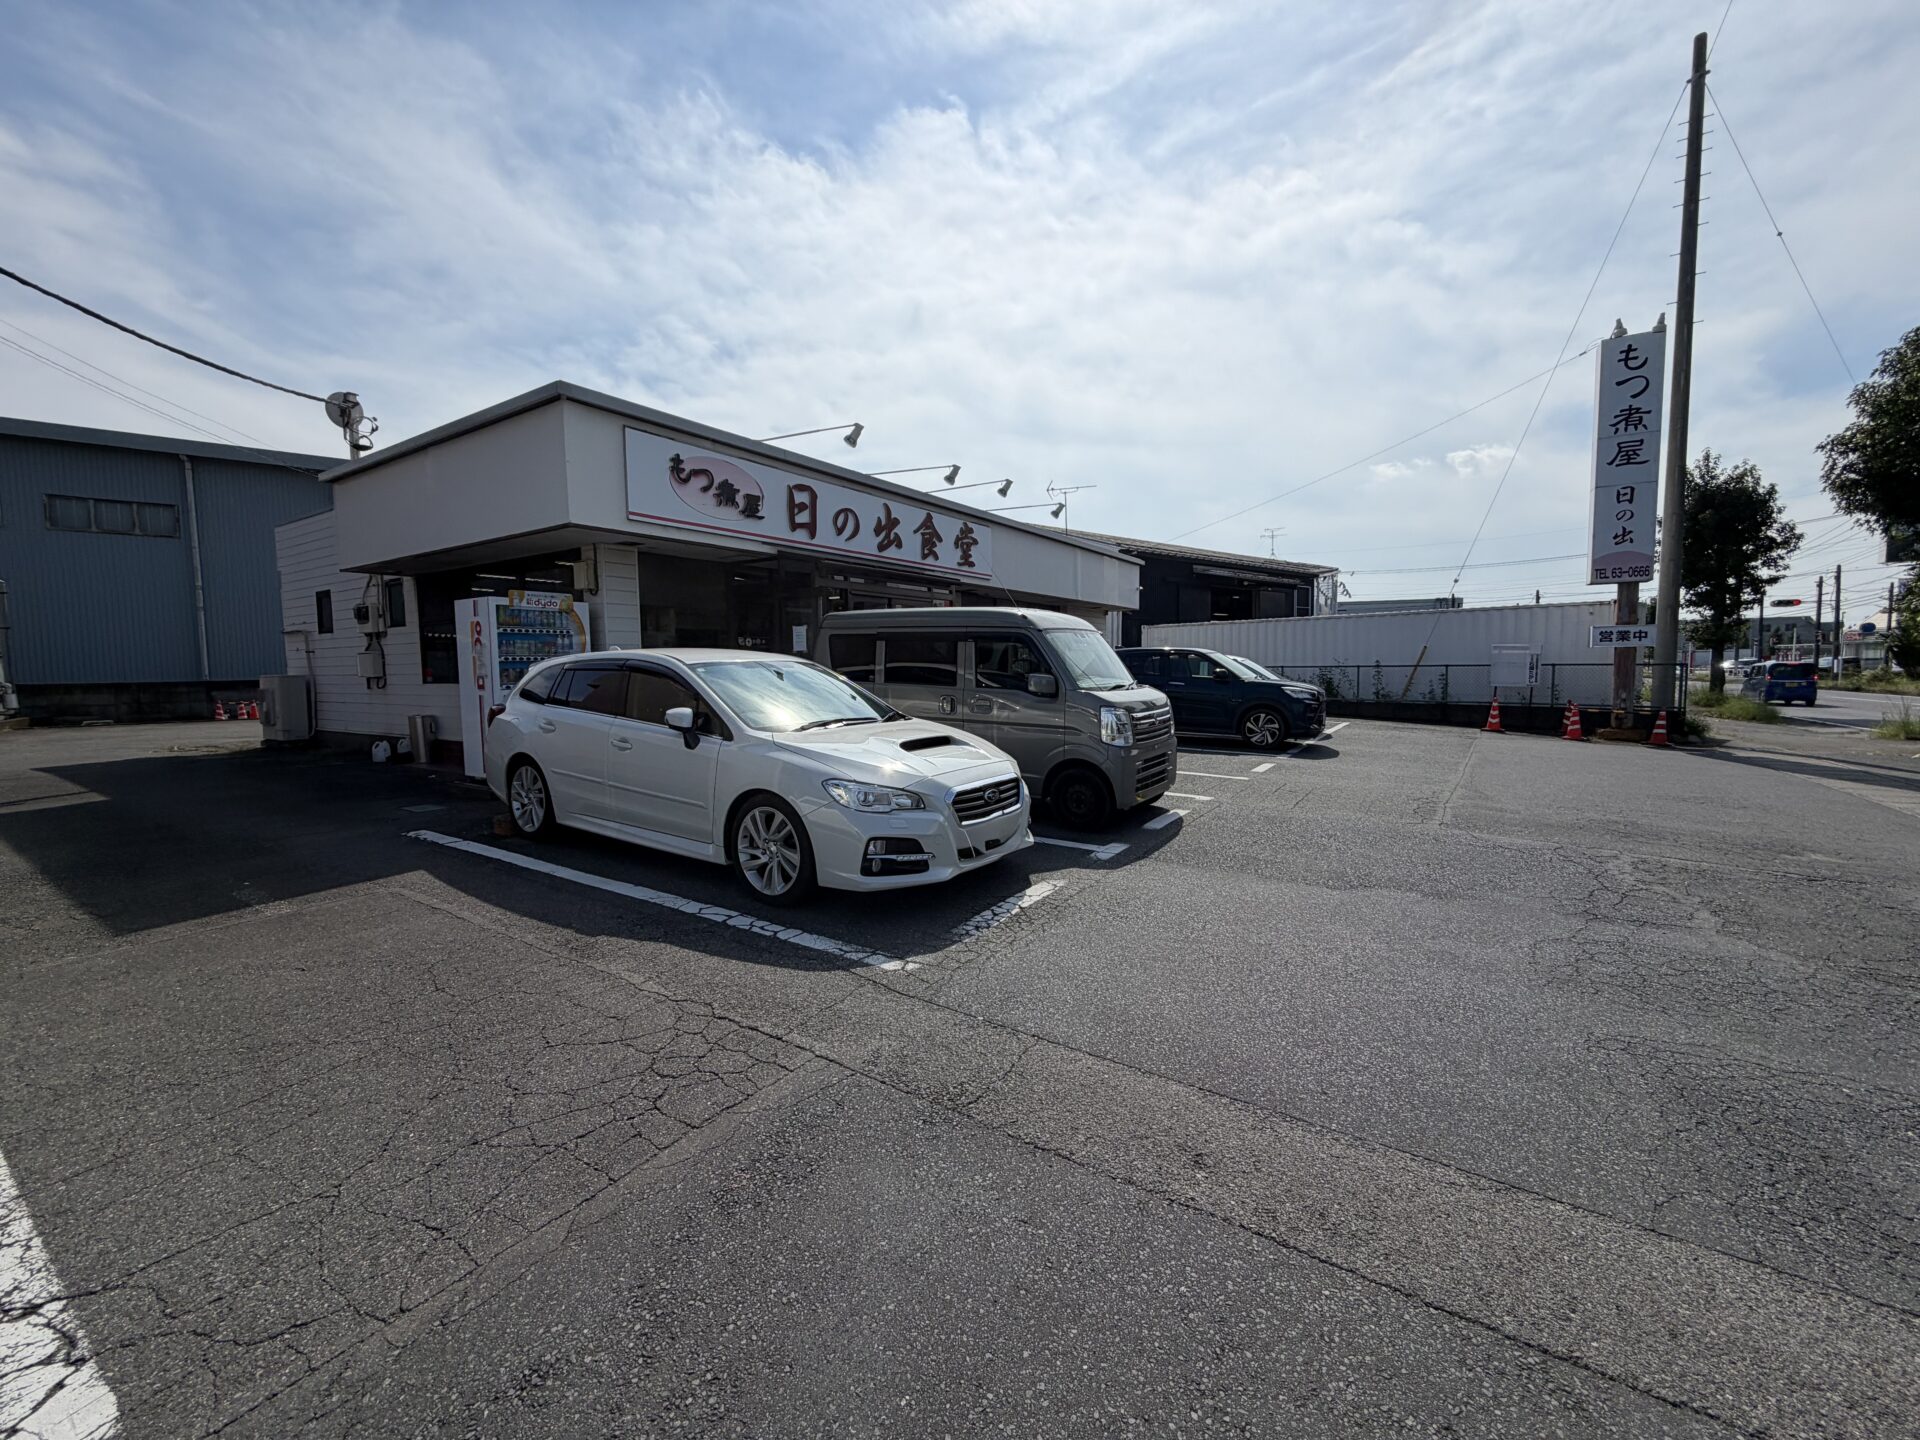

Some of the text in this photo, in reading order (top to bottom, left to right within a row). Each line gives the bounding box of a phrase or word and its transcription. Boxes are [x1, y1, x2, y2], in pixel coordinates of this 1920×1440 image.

[1606, 343, 1653, 468] もつ煮屋
[787, 483, 979, 568] 日の出食堂
[1612, 485, 1635, 545] 日の出
[1595, 566, 1650, 579] TEL 63-0666
[1599, 629, 1648, 642] 営業中
